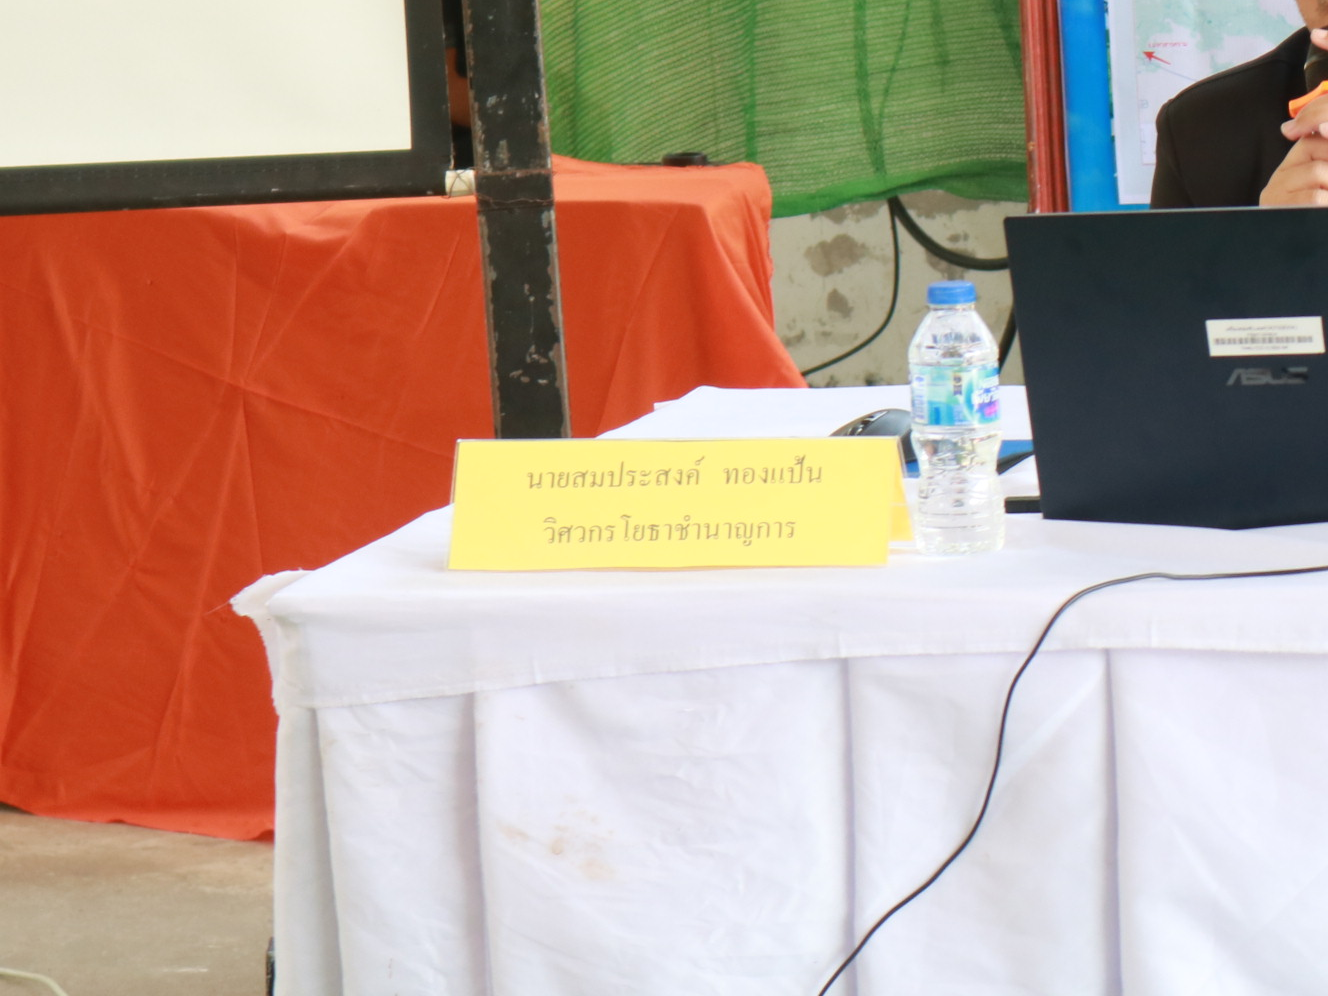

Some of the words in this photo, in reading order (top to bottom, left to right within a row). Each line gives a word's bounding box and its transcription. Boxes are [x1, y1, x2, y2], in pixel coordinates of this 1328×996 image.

[526, 455, 705, 489] นายสมประสงค์
